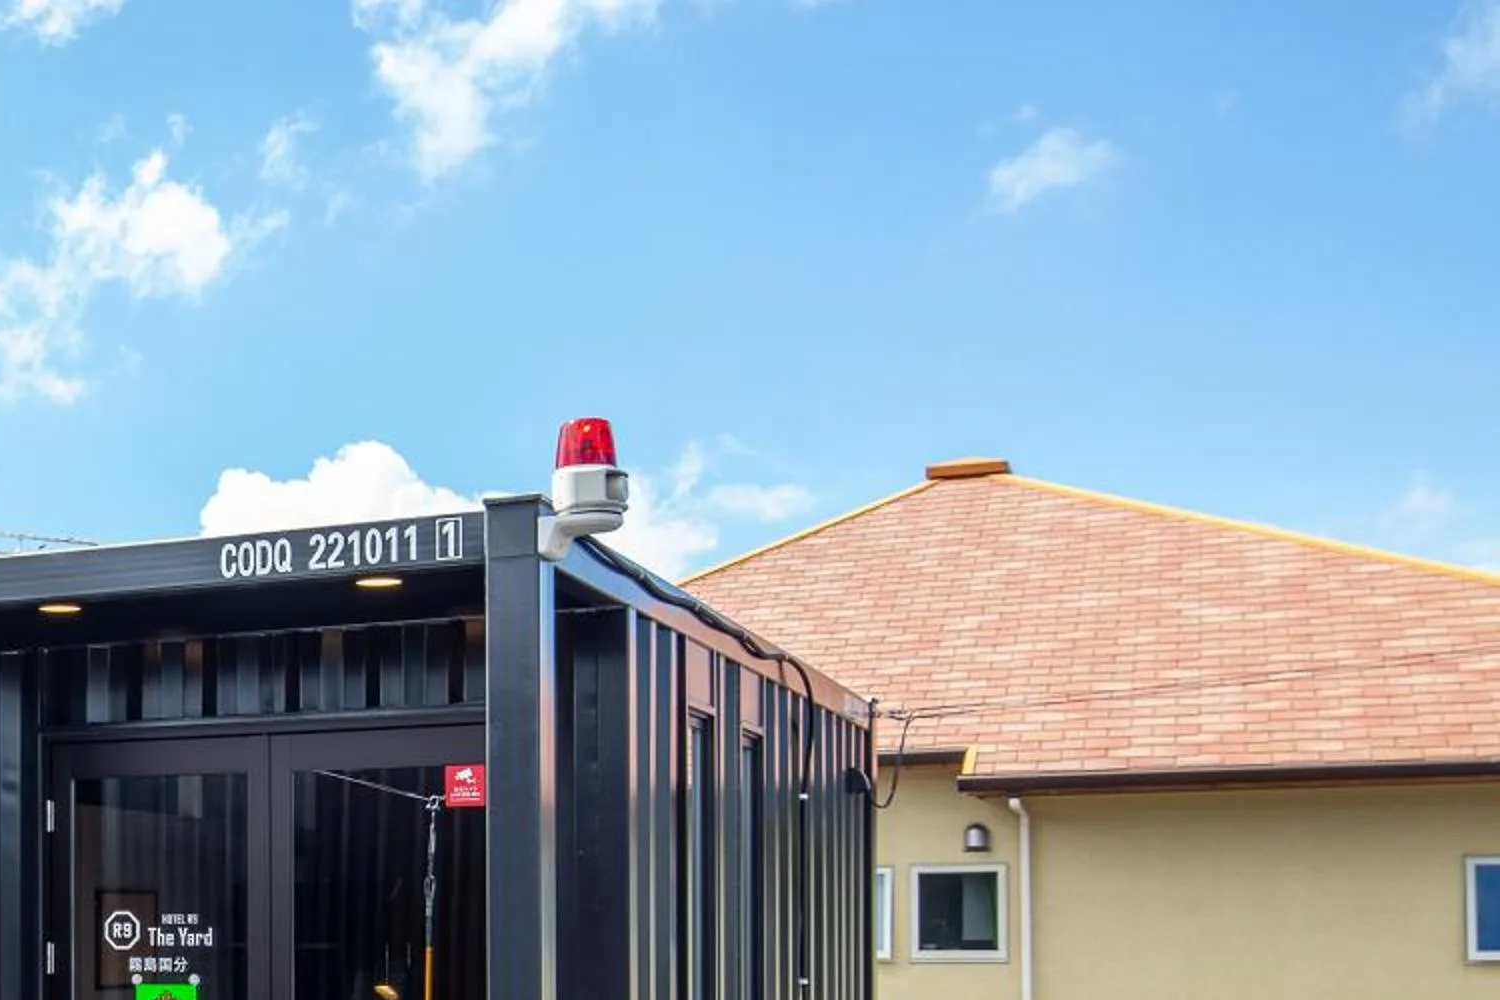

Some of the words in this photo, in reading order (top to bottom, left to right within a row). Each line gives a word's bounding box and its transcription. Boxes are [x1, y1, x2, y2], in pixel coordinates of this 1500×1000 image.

[220, 538, 292, 578] CODQ
[308, 525, 417, 570] 221011
[438, 519, 458, 559] 1
[112, 921, 133, 939] R9
[147, 926, 175, 947] The
[178, 926, 213, 947] Yard
